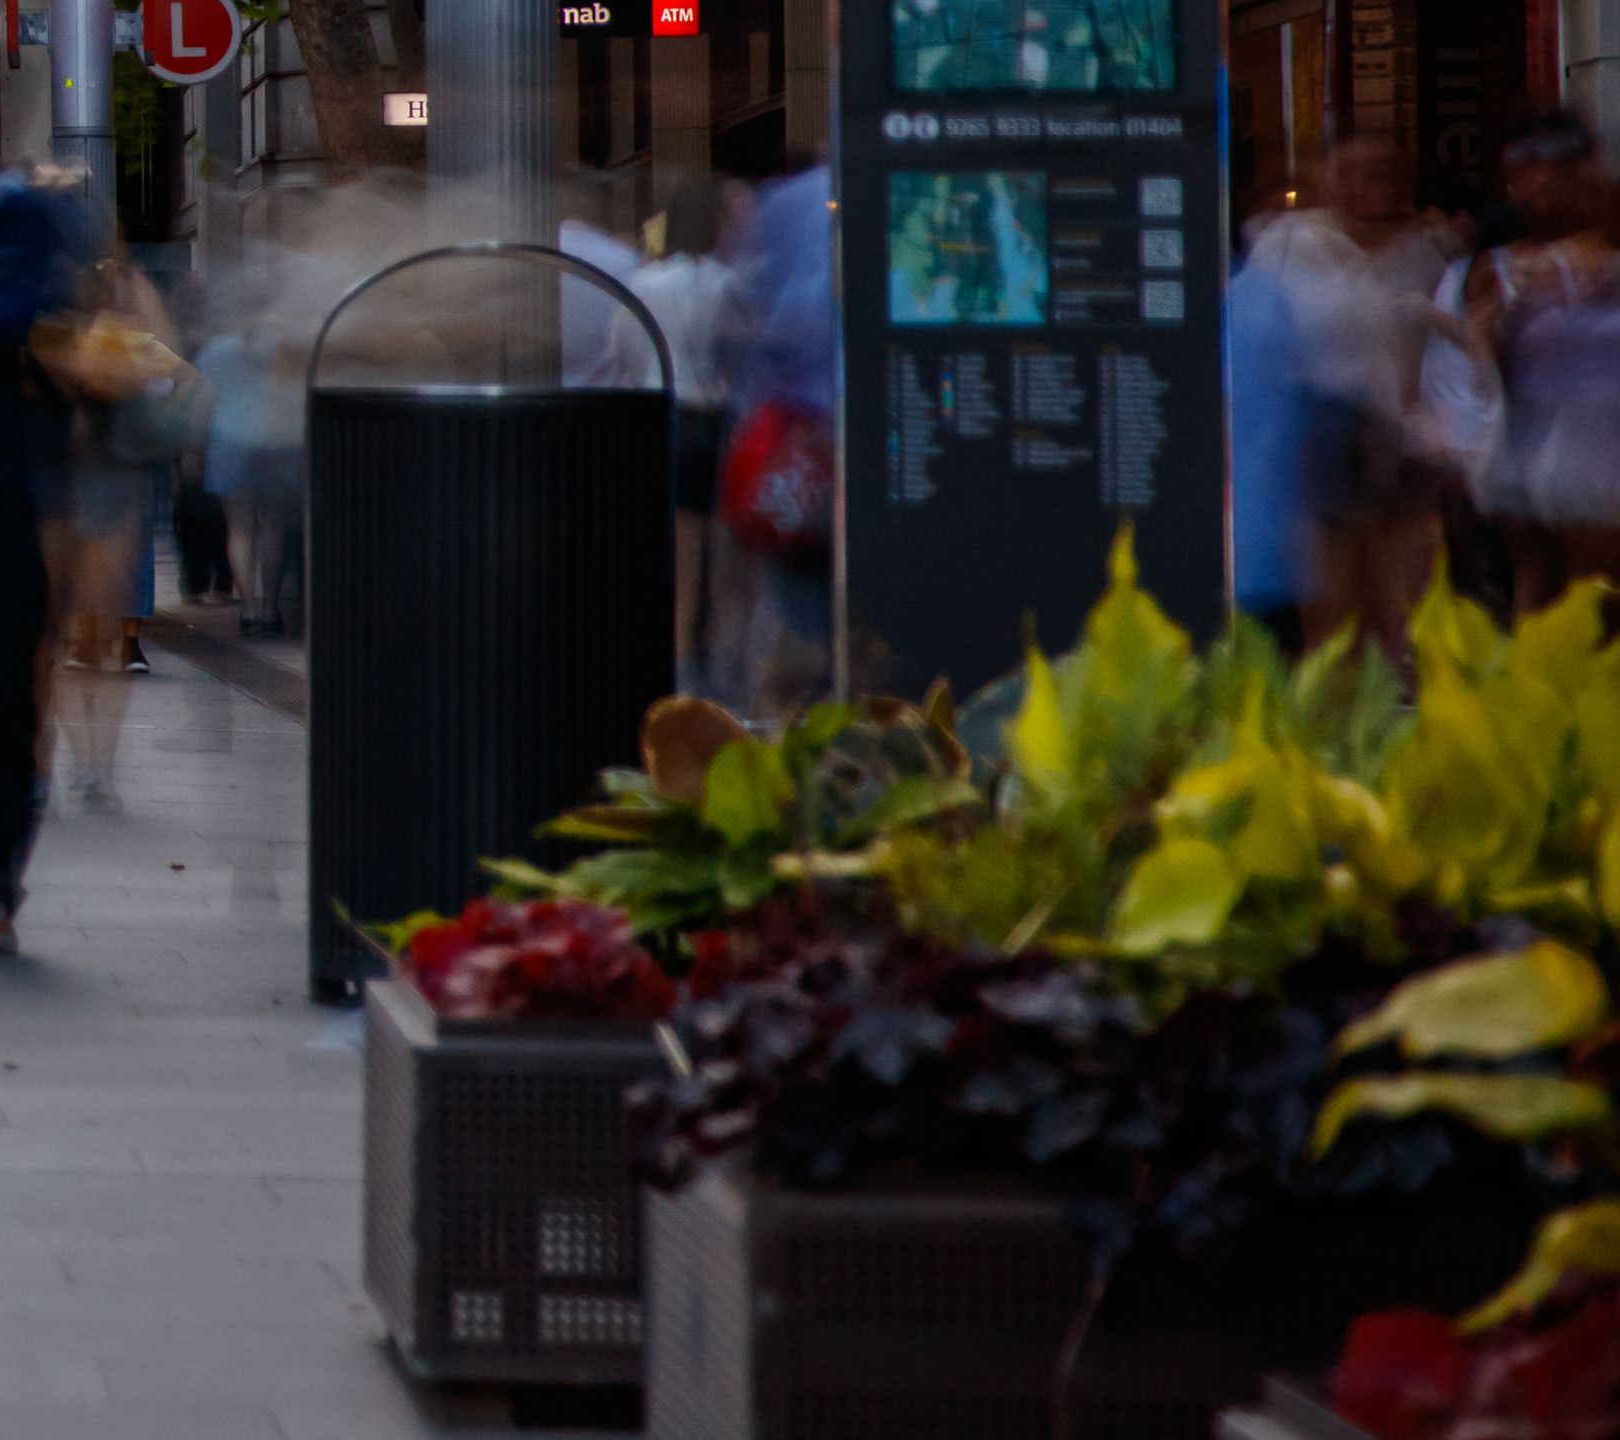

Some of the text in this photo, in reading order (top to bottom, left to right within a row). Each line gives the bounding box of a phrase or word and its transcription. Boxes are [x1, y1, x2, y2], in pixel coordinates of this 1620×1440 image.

[563, 2, 610, 25] nab
[660, 7, 693, 23] ATM
[171, 2, 207, 58] L
[407, 100, 424, 118] H
[1045, 116, 1119, 138] location
